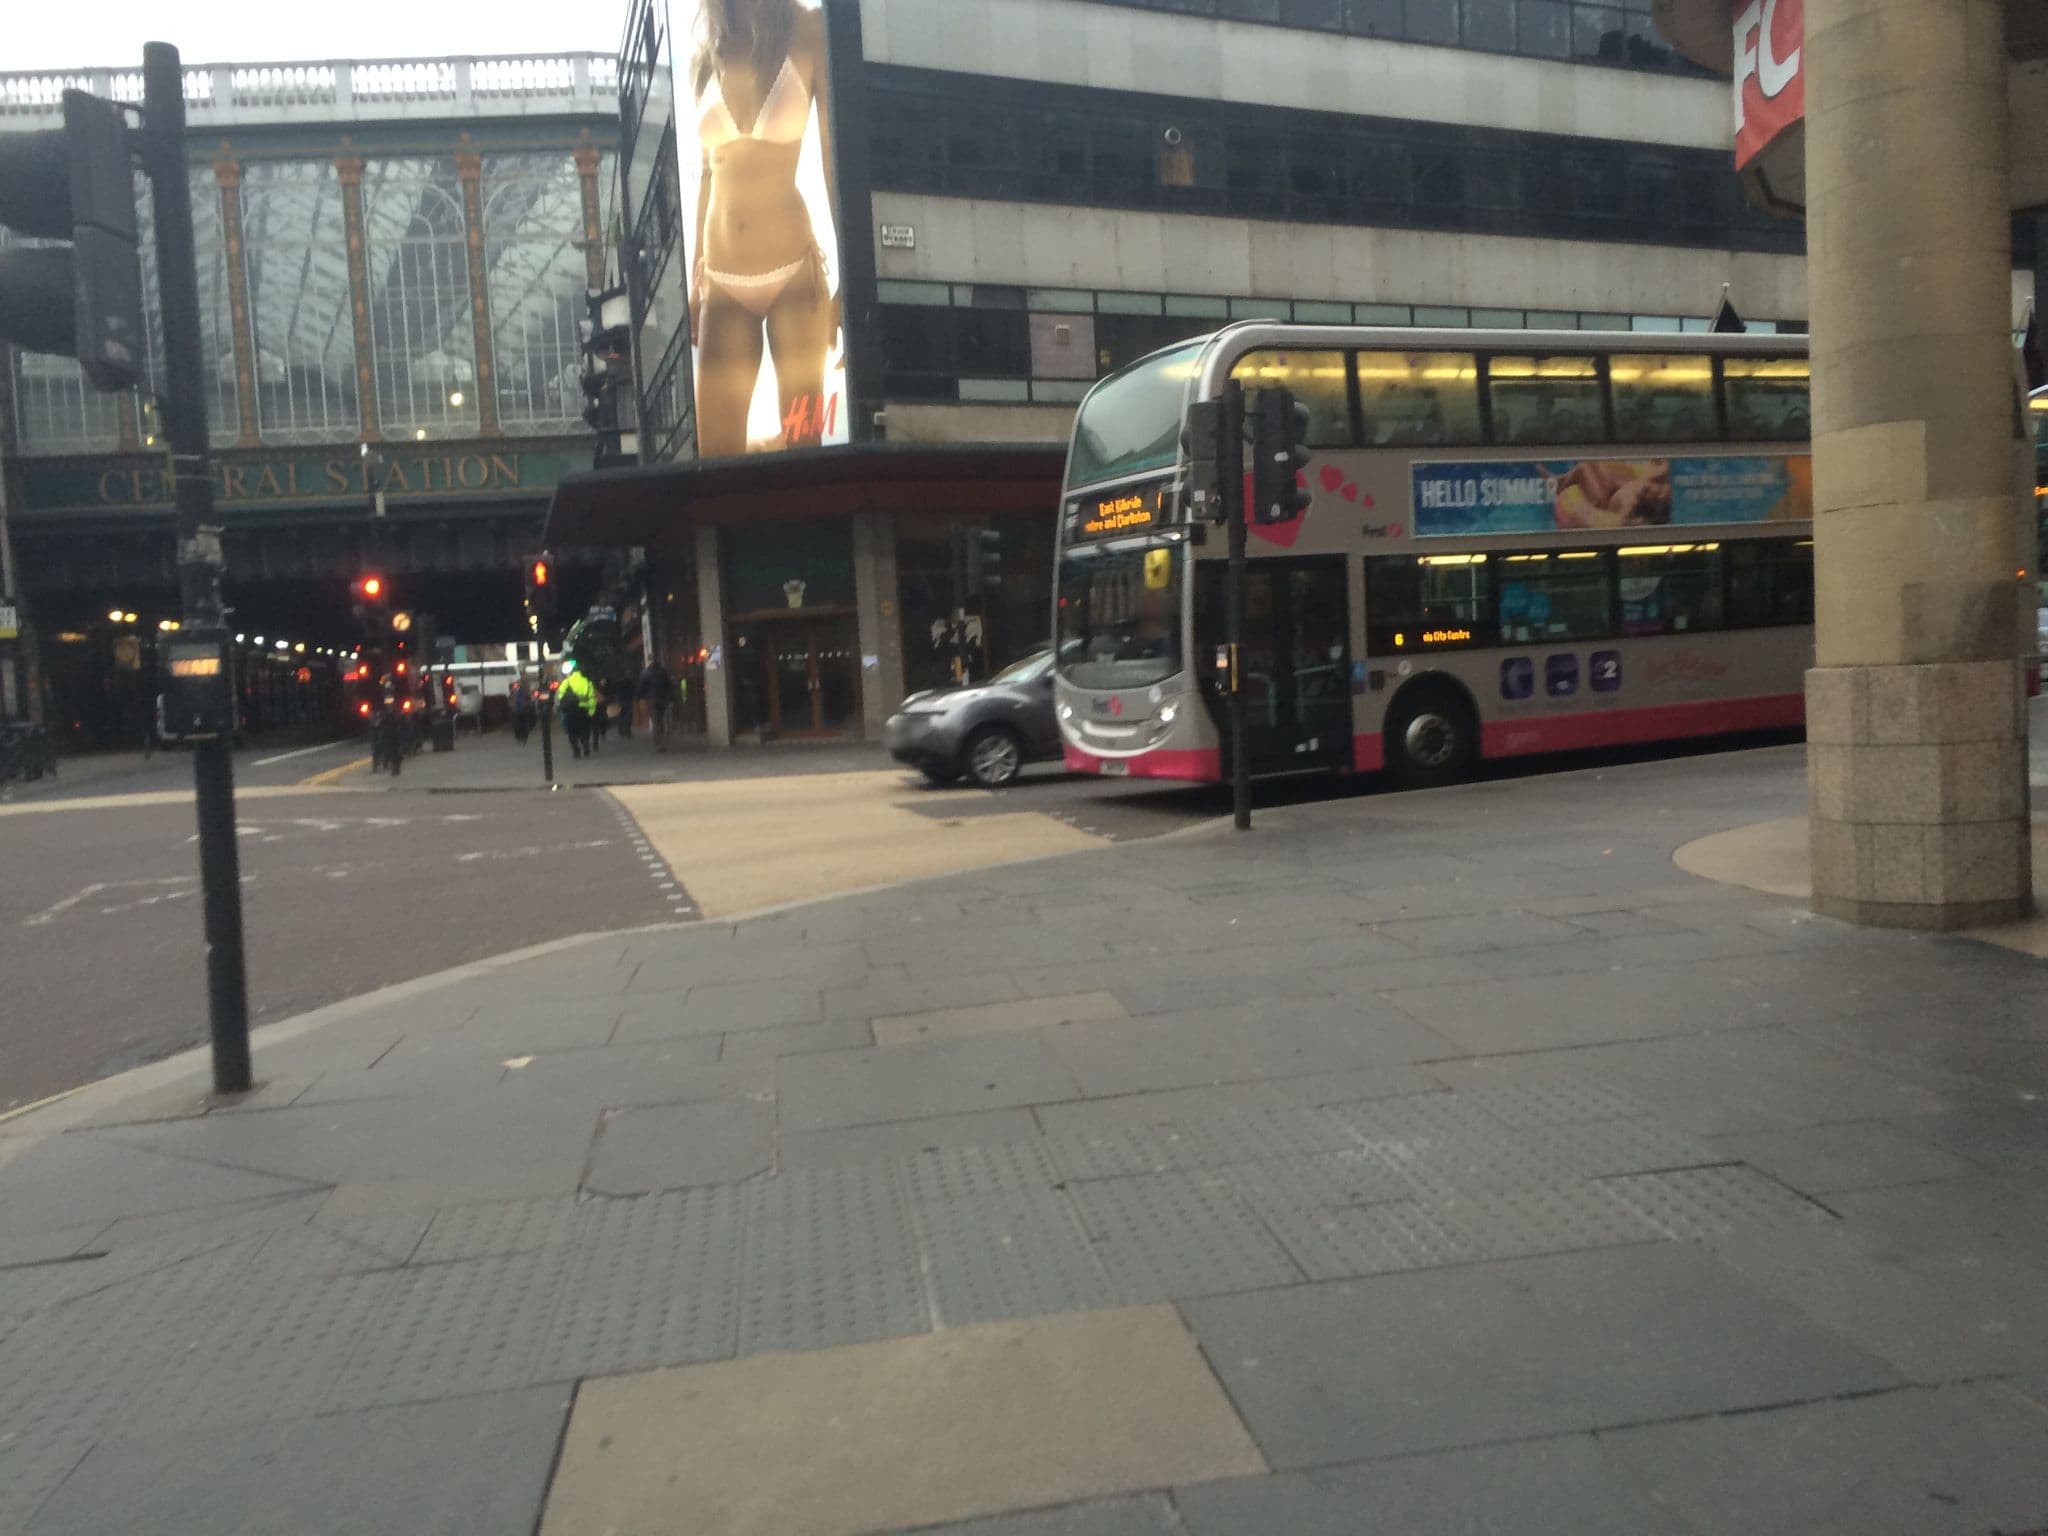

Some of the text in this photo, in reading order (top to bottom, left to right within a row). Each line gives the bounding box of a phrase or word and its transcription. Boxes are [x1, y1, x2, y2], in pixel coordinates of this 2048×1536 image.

[99, 454, 519, 503] CENRAL STATION
[1421, 477, 1558, 508] HELLO SUMMER
[1099, 501, 1115, 517] East
[1423, 632, 1433, 642] via
[1433, 630, 1447, 642] City
[1447, 629, 1470, 641] Centre
